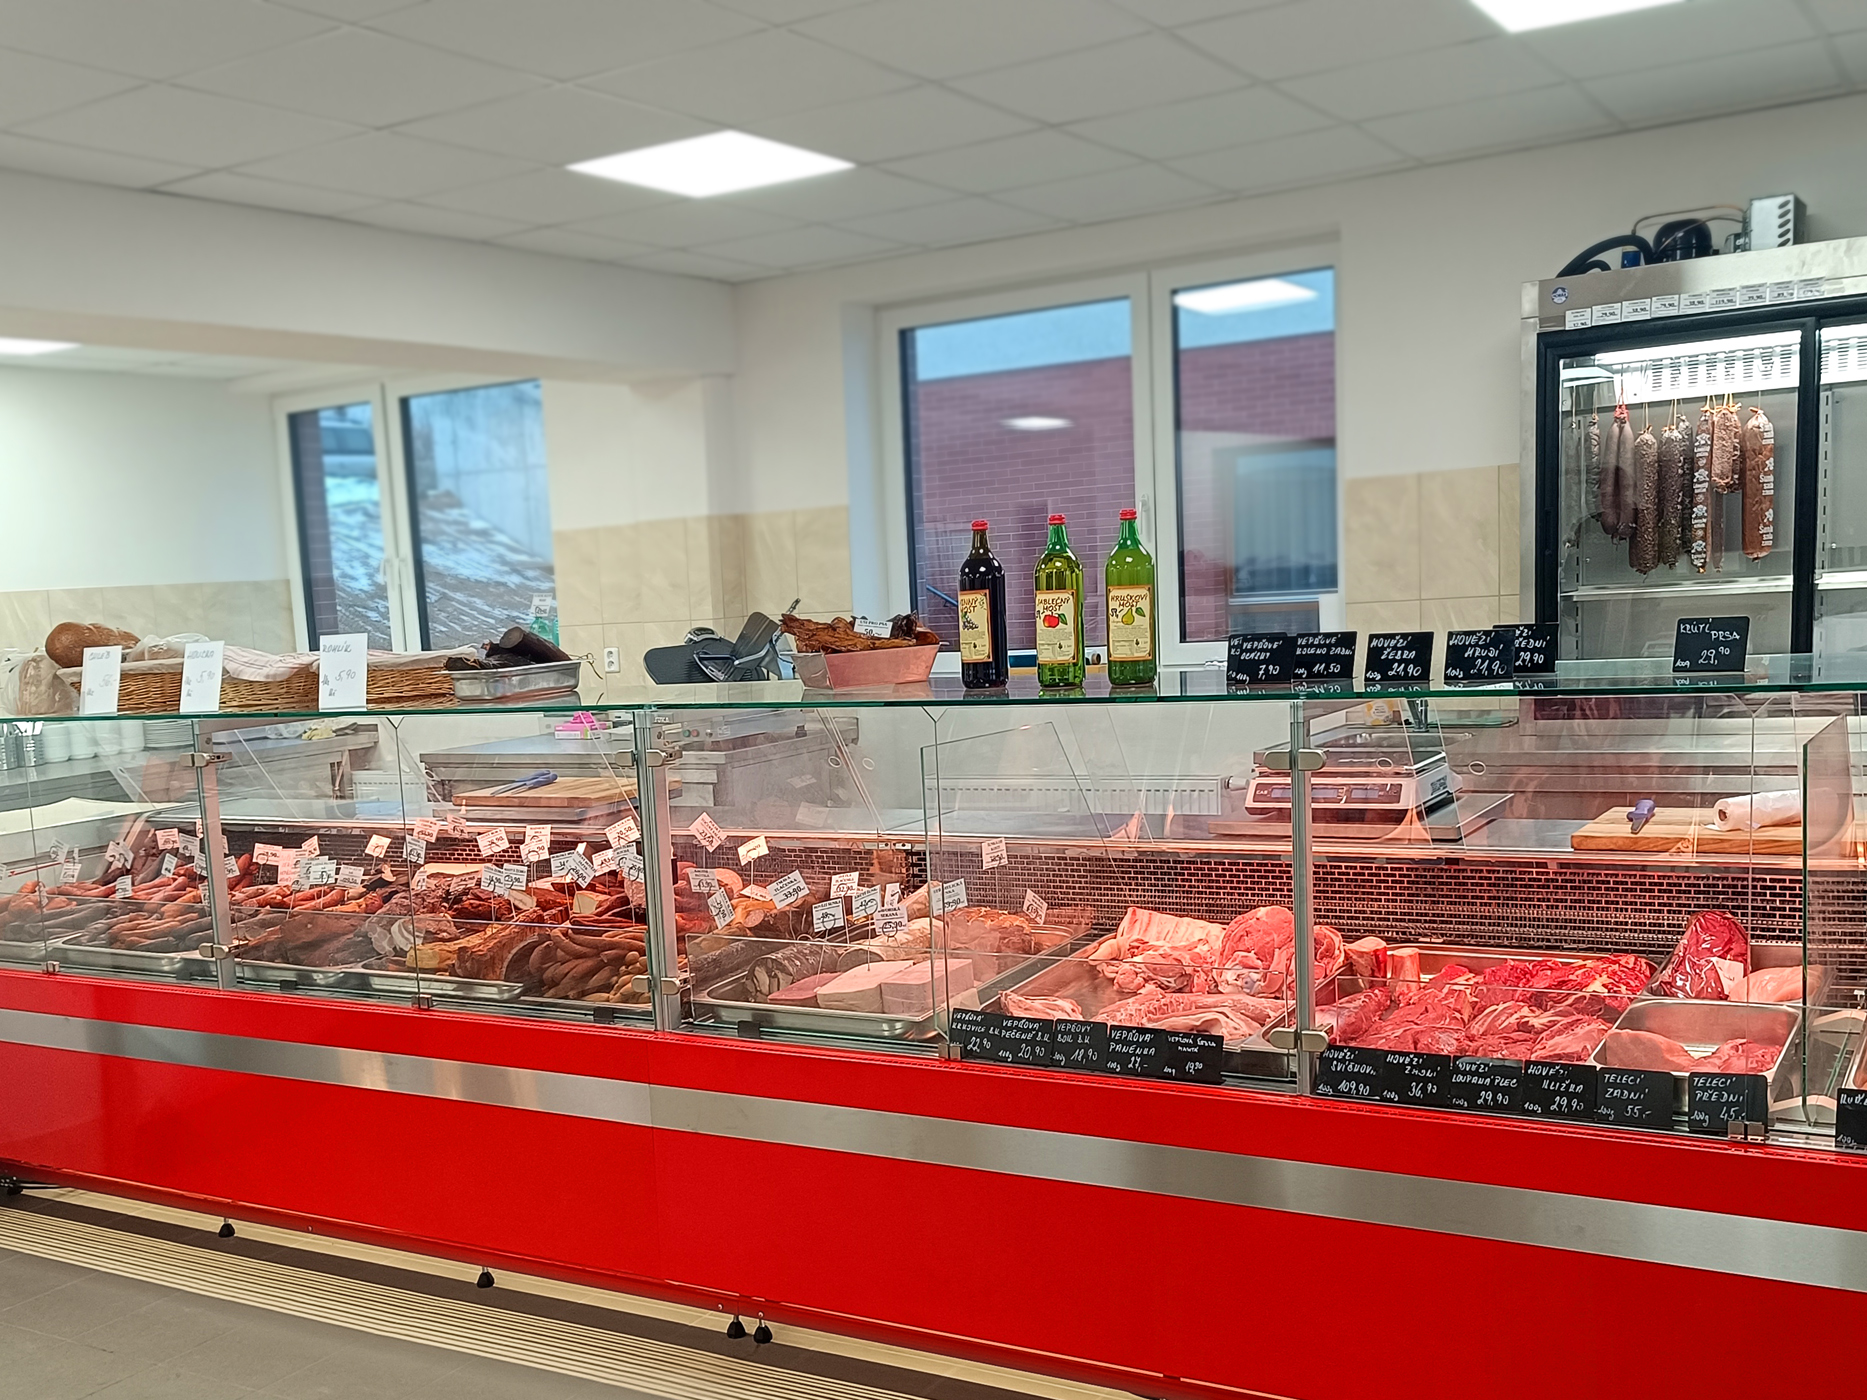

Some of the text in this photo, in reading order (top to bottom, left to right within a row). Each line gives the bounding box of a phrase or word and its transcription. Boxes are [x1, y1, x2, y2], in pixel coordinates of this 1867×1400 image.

[1710, 631, 1740, 641] PRSA
[1604, 1074, 1645, 1084] TELECÍ
[1693, 1077, 1736, 1087] TELECÍ
[1337, 1080, 1370, 1096] 109,90
[1605, 1088, 1649, 1099] ZADNÍ
